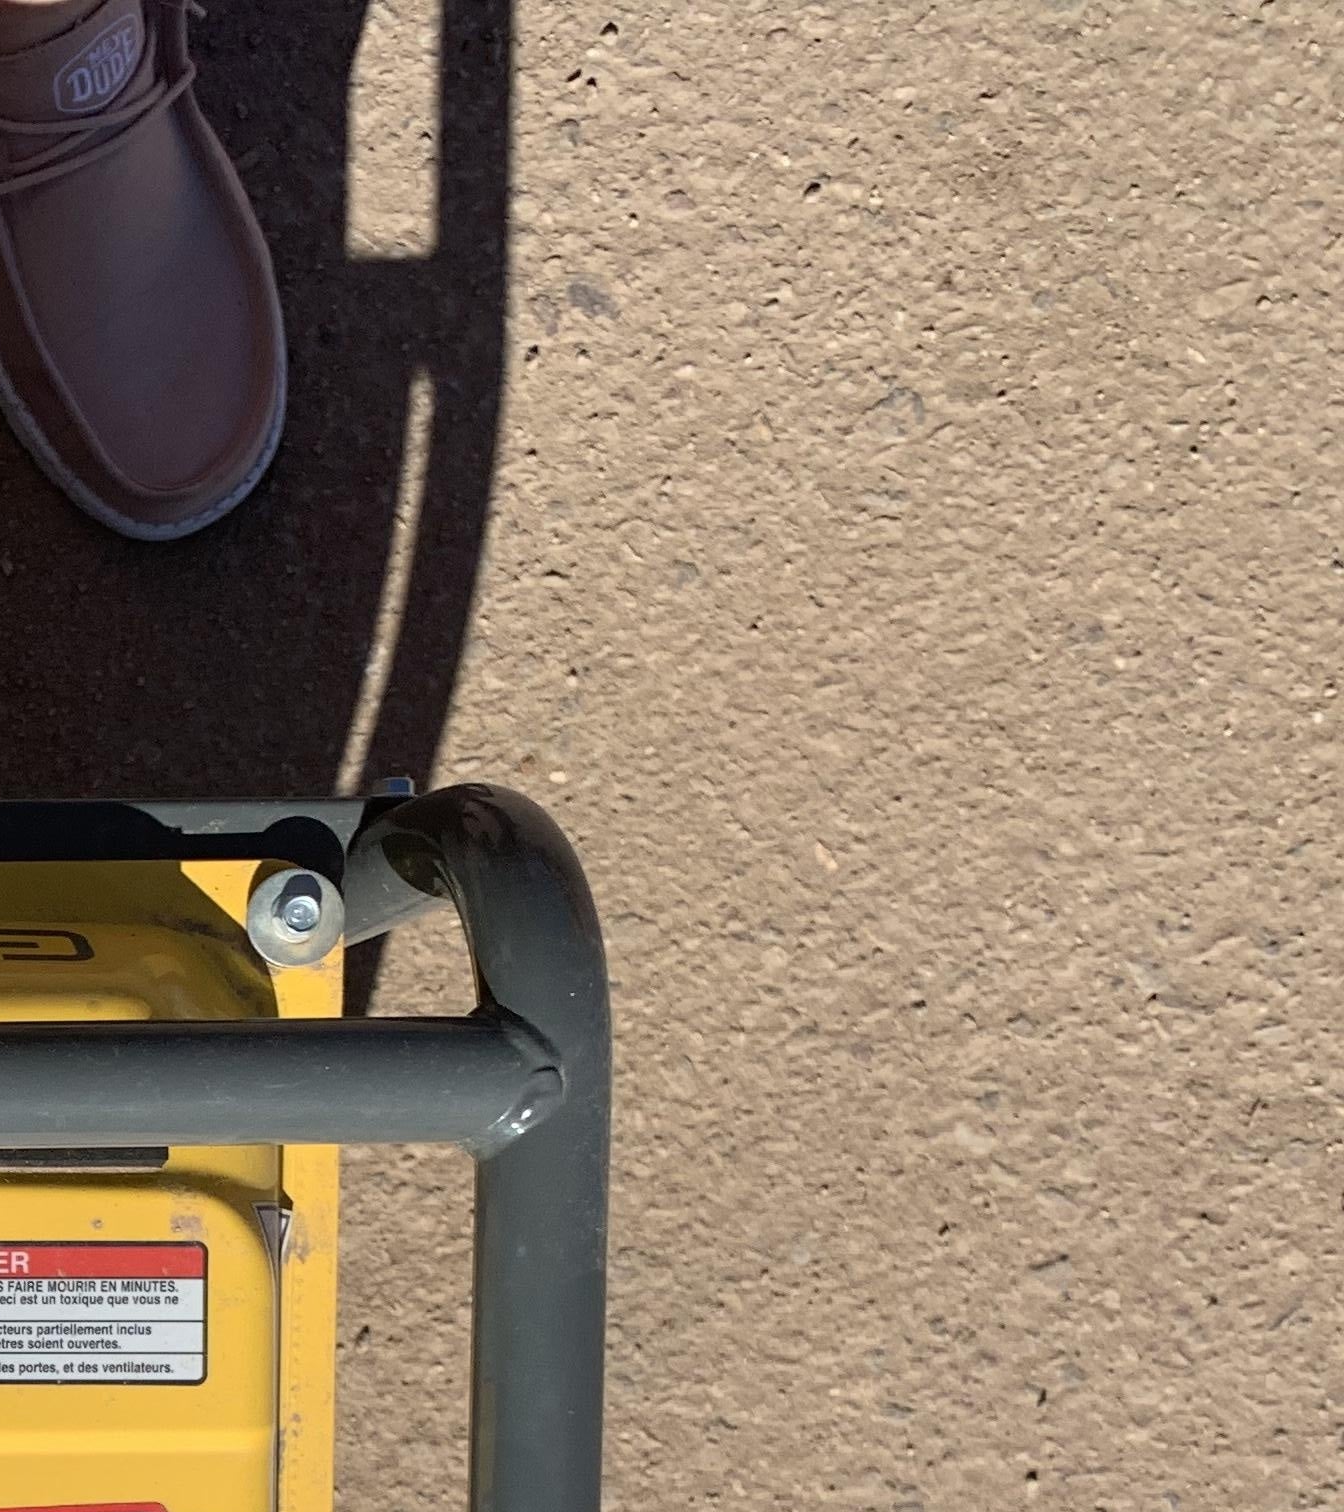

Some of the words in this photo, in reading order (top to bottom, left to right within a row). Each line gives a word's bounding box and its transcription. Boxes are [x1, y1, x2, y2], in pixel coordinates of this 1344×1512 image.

[67, 27, 134, 103] DUDE
[7, 1281, 44, 1292] FAIRE
[47, 1281, 97, 1292] MOURIR
[100, 1281, 117, 1292] EN
[120, 1282, 178, 1293] MINUTES.
[18, 1362, 60, 1376] portes,
[62, 1362, 75, 1373] et
[77, 1362, 99, 1373] des
[102, 1362, 174, 1373] ventilateurs.
